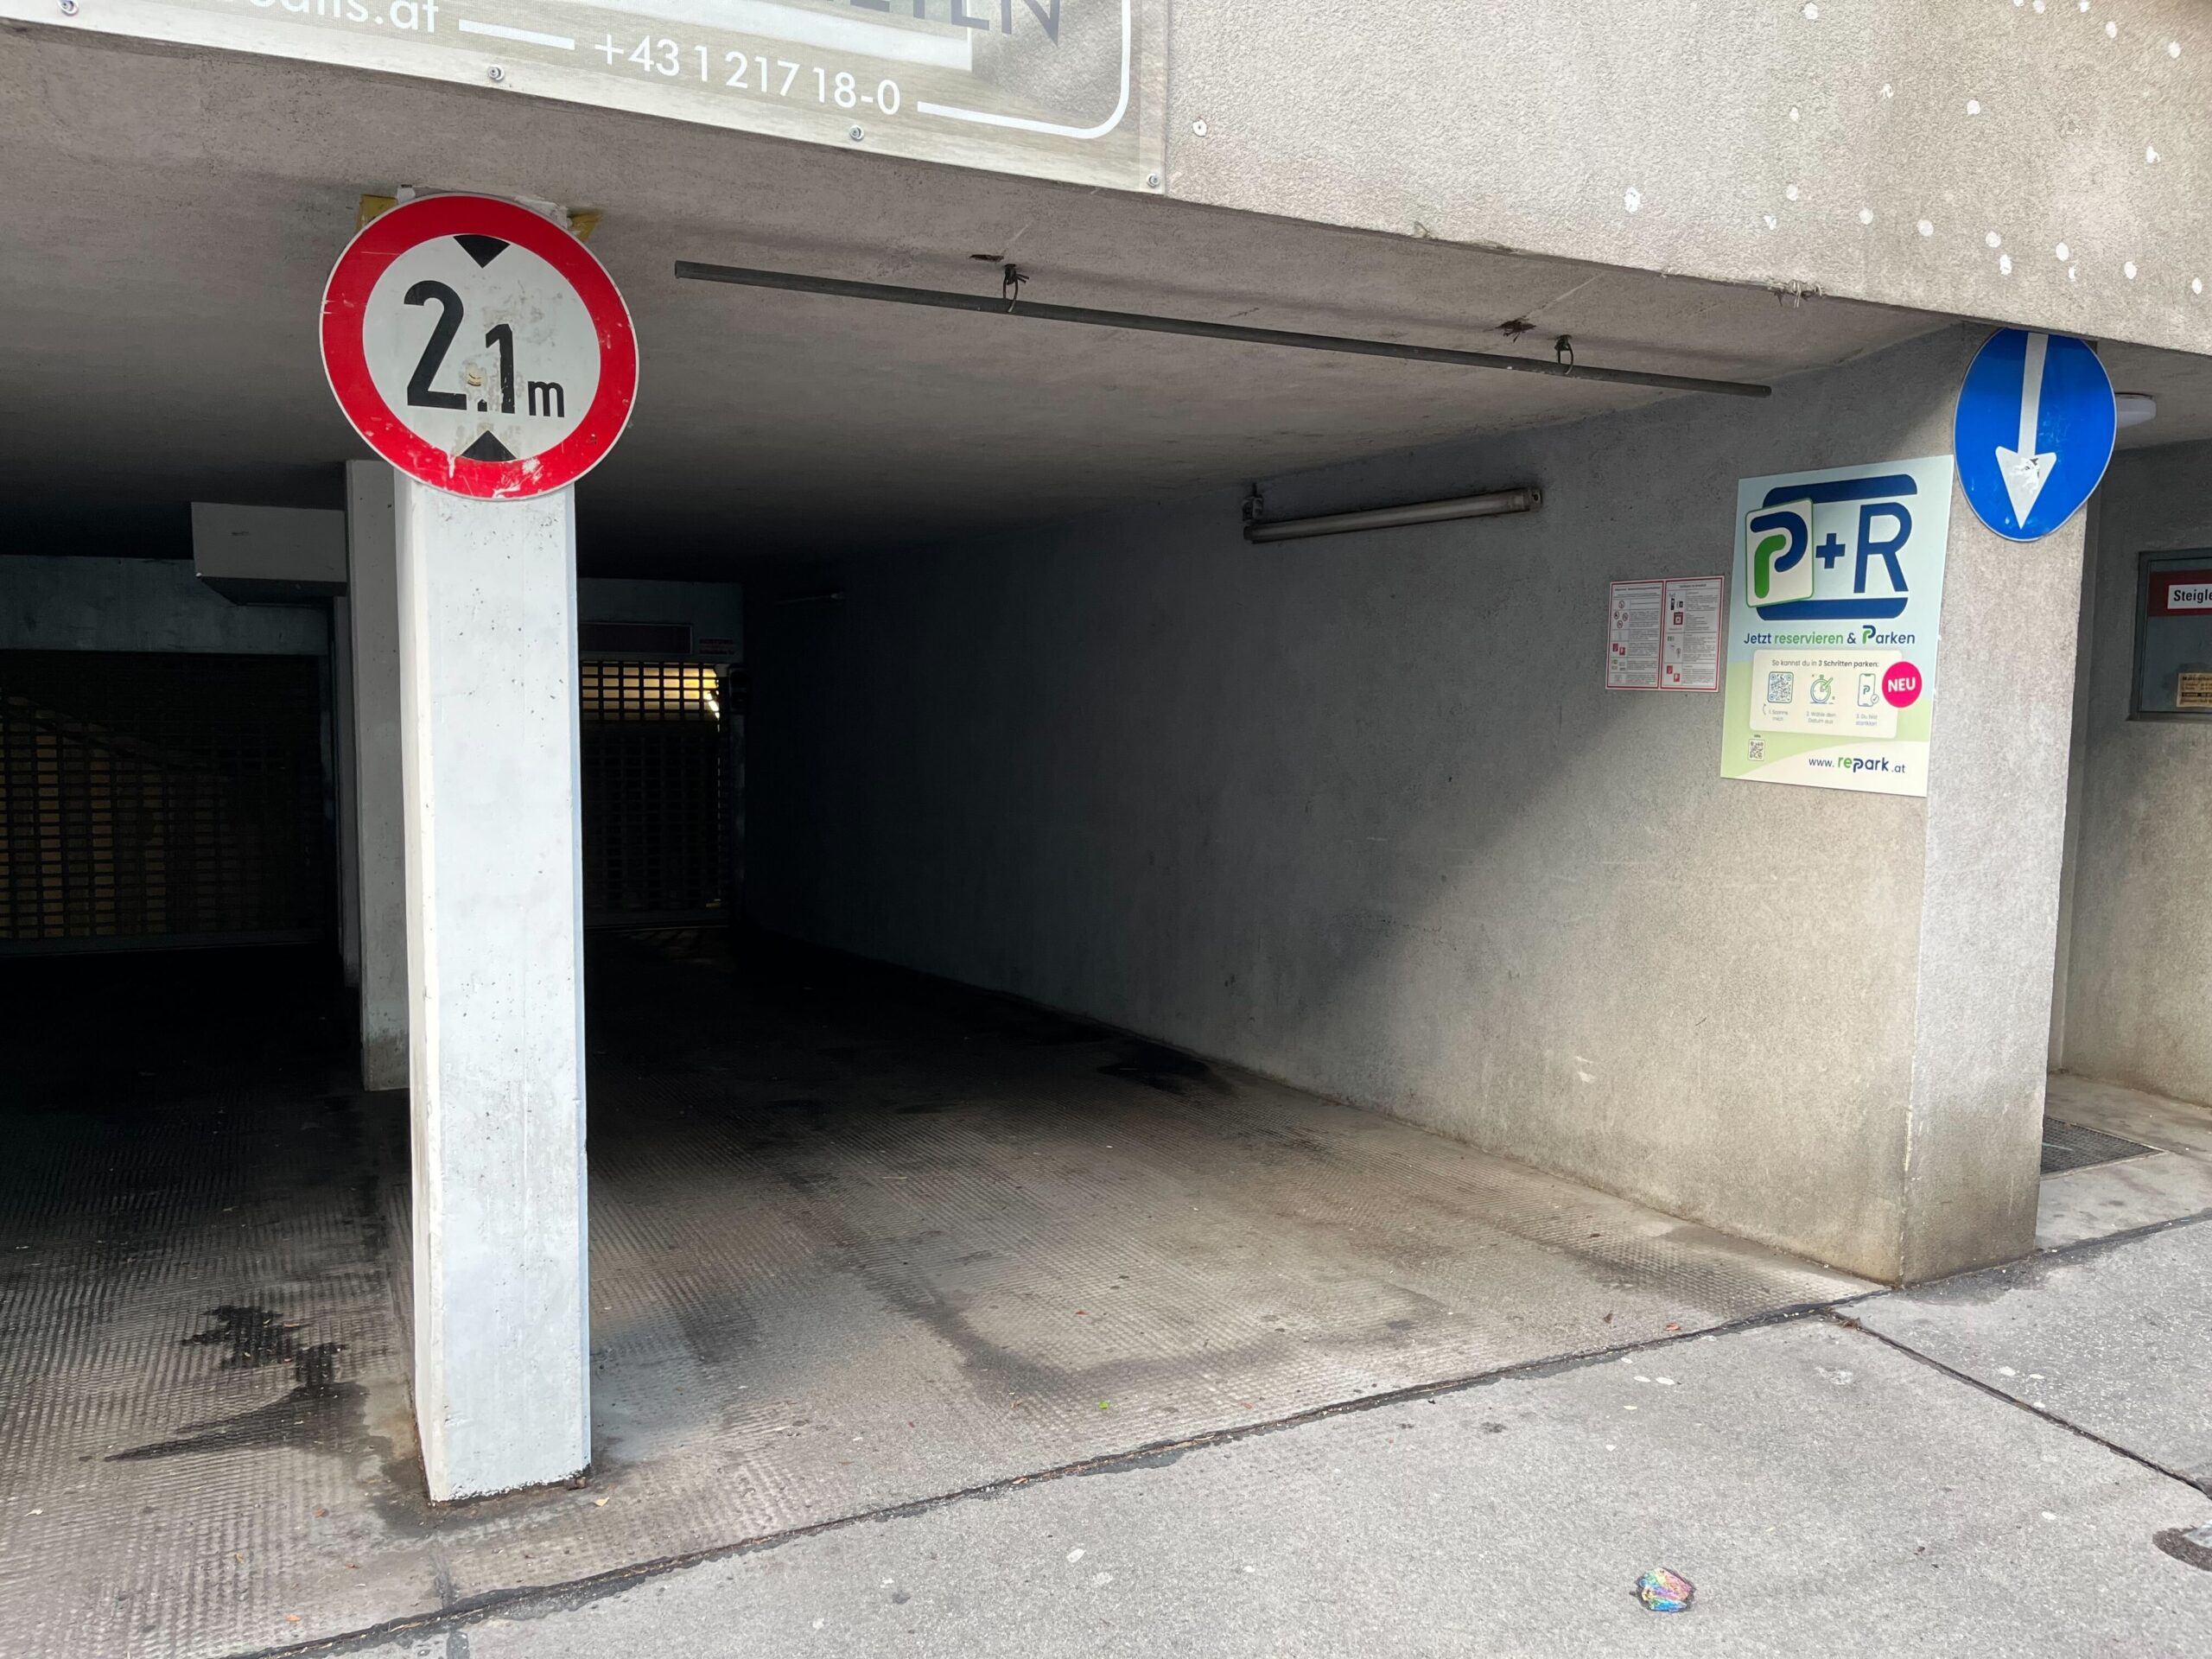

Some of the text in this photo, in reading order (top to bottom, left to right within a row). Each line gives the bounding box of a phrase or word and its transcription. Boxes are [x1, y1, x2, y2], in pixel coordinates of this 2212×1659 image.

[594, 34, 900, 115] +43 1 217 18-0
[528, 380, 565, 417] m
[1744, 625, 1916, 645] Jetzt reservieren & Parken
[1823, 659, 1853, 668] Schritten
[1853, 660, 1880, 670] parken:
[1887, 677, 1916, 692] NEU
